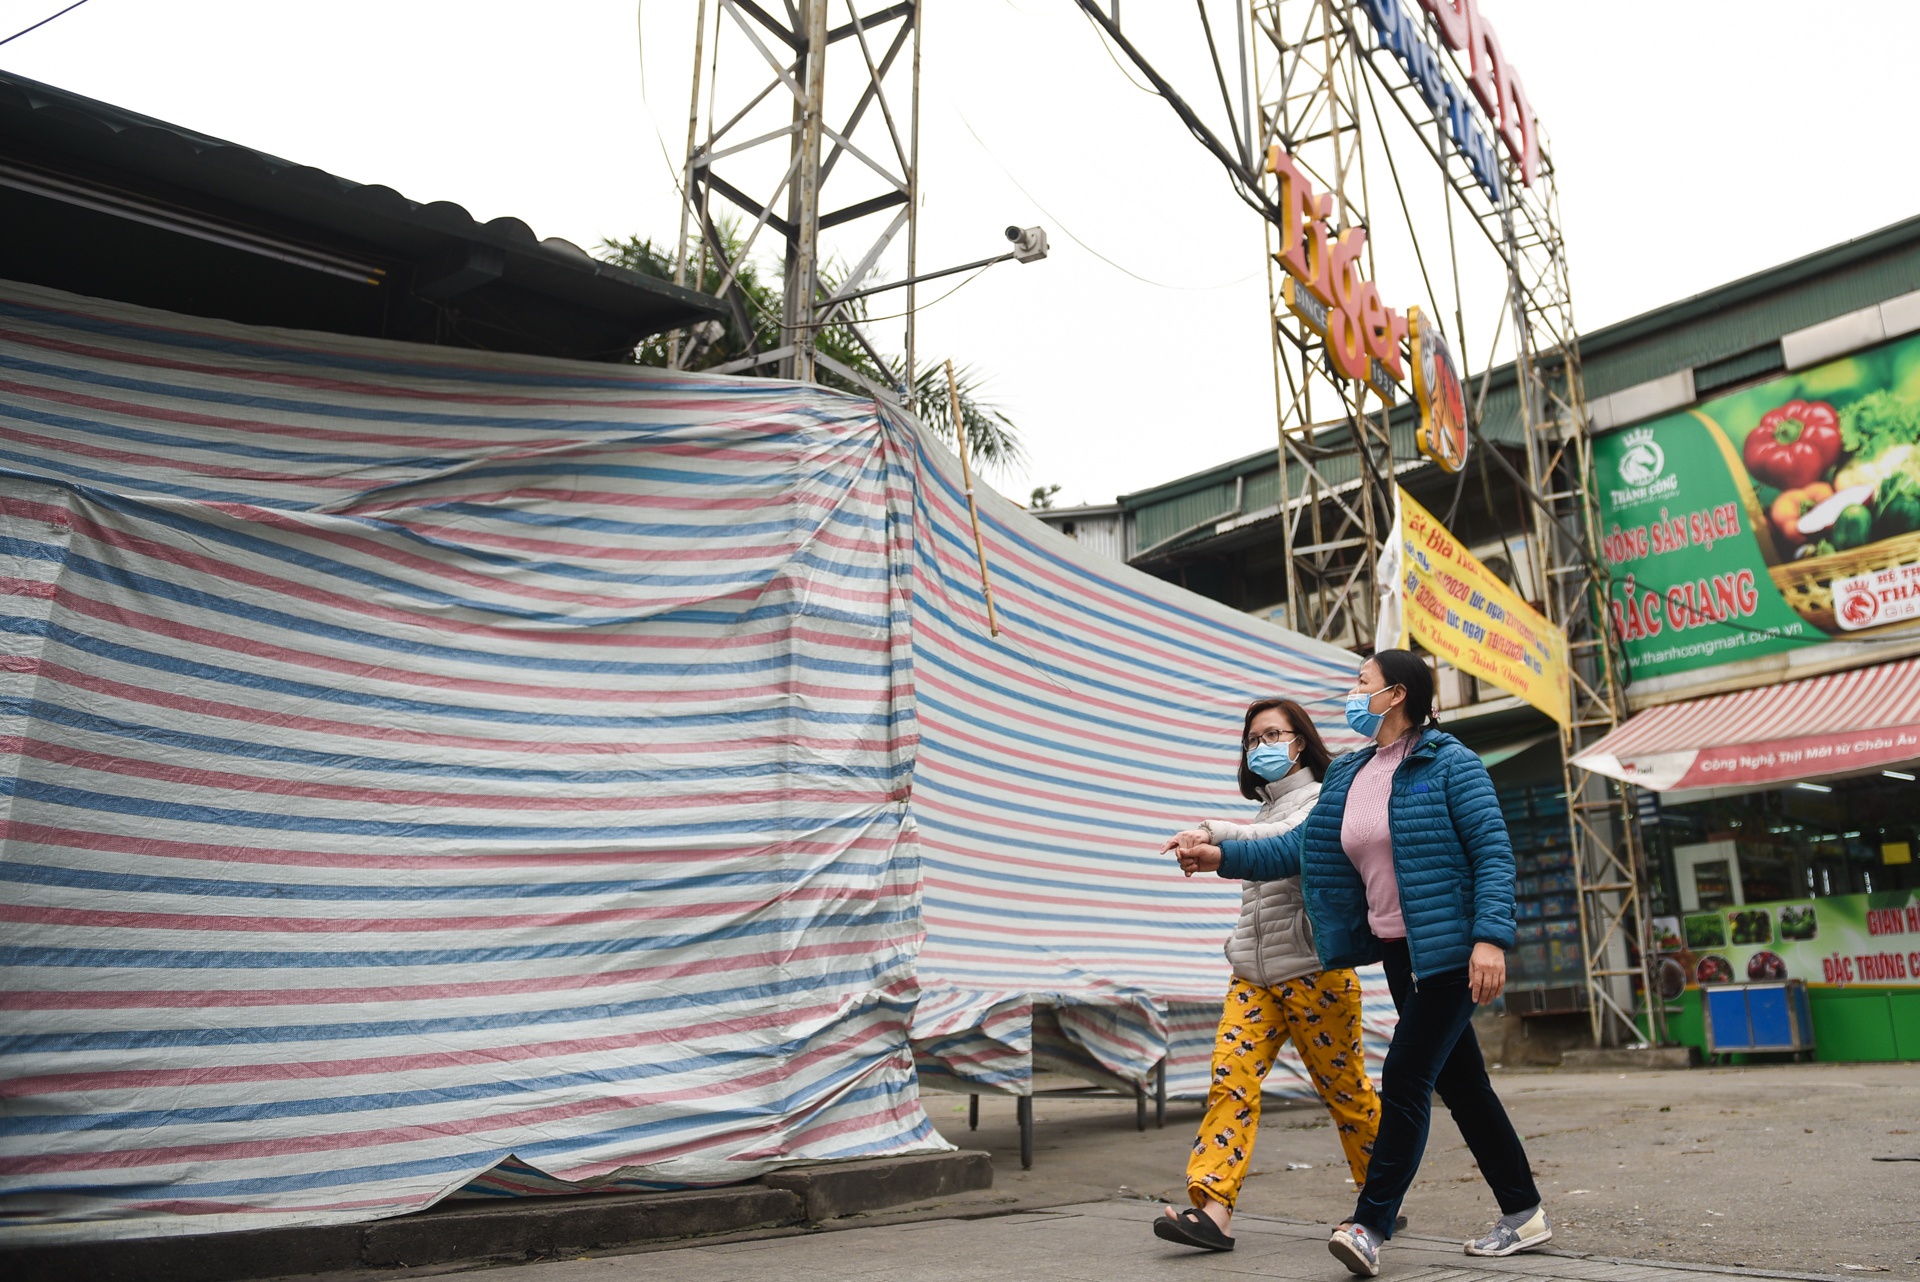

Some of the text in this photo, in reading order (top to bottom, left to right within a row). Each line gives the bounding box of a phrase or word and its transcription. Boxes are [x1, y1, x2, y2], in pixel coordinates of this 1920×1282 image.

[1267, 144, 1409, 381] Tiger
[1295, 284, 1396, 397] SINCE 1932
[1611, 473, 1678, 506] THÀNH CÔNG
[1604, 501, 1741, 565] NÔNG SẢN SẠCH
[1610, 567, 1759, 644] BẮC GIANG
[1462, 619, 1486, 643] ngày
[1701, 758, 1737, 772] Công
[1740, 752, 1776, 768] Nghệ
[1854, 737, 1893, 753] Châu
[1896, 731, 1917, 746] Âu
[1866, 899, 1920, 936] GIAN H
[1822, 950, 1920, 989] ĐẶC TRƯNG C
